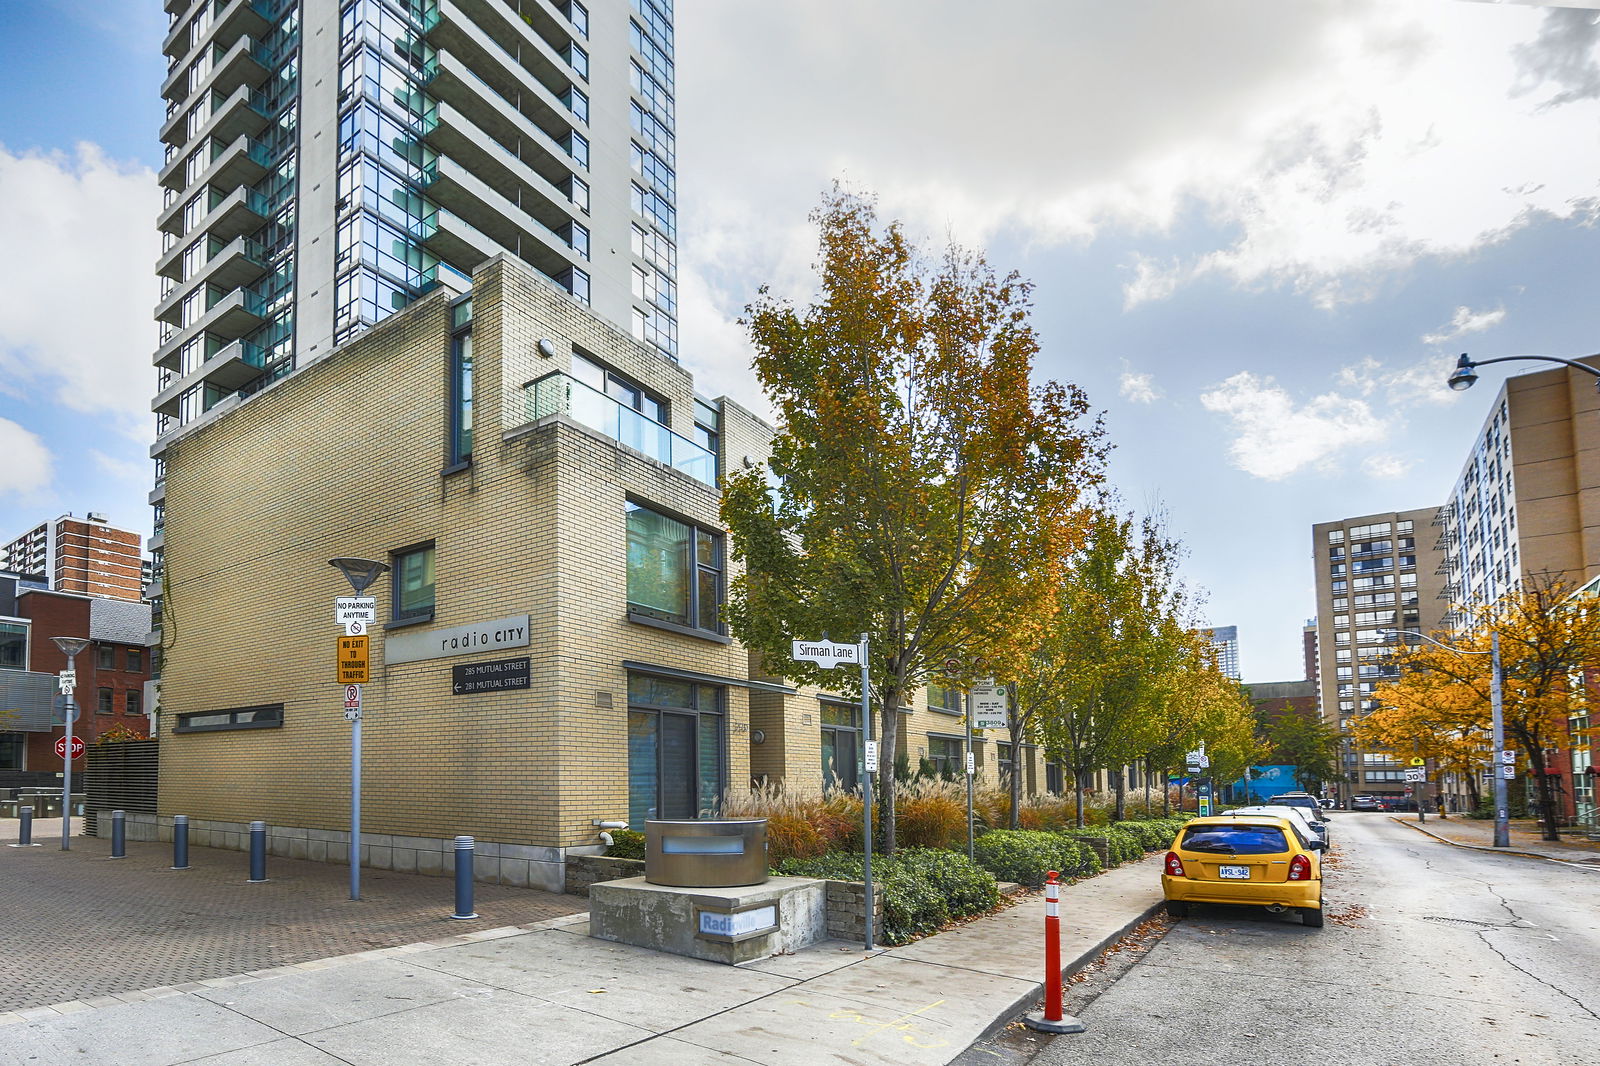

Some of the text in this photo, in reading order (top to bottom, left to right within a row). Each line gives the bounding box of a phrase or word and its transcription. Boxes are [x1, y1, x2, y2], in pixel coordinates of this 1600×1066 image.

[338, 602, 347, 610] NO
[442, 627, 524, 650] radio CITY
[343, 640, 364, 648] NO EXIT
[350, 650, 357, 658] TO
[800, 644, 853, 658] Sirman Lane
[341, 660, 366, 669] THROUGH
[476, 664, 503, 675] MUTUAL
[504, 661, 528, 670] STREET
[342, 670, 364, 679] TRAFFIC
[465, 676, 528, 691] 281 MUTUAL STREET
[58, 743, 83, 752] SOP
